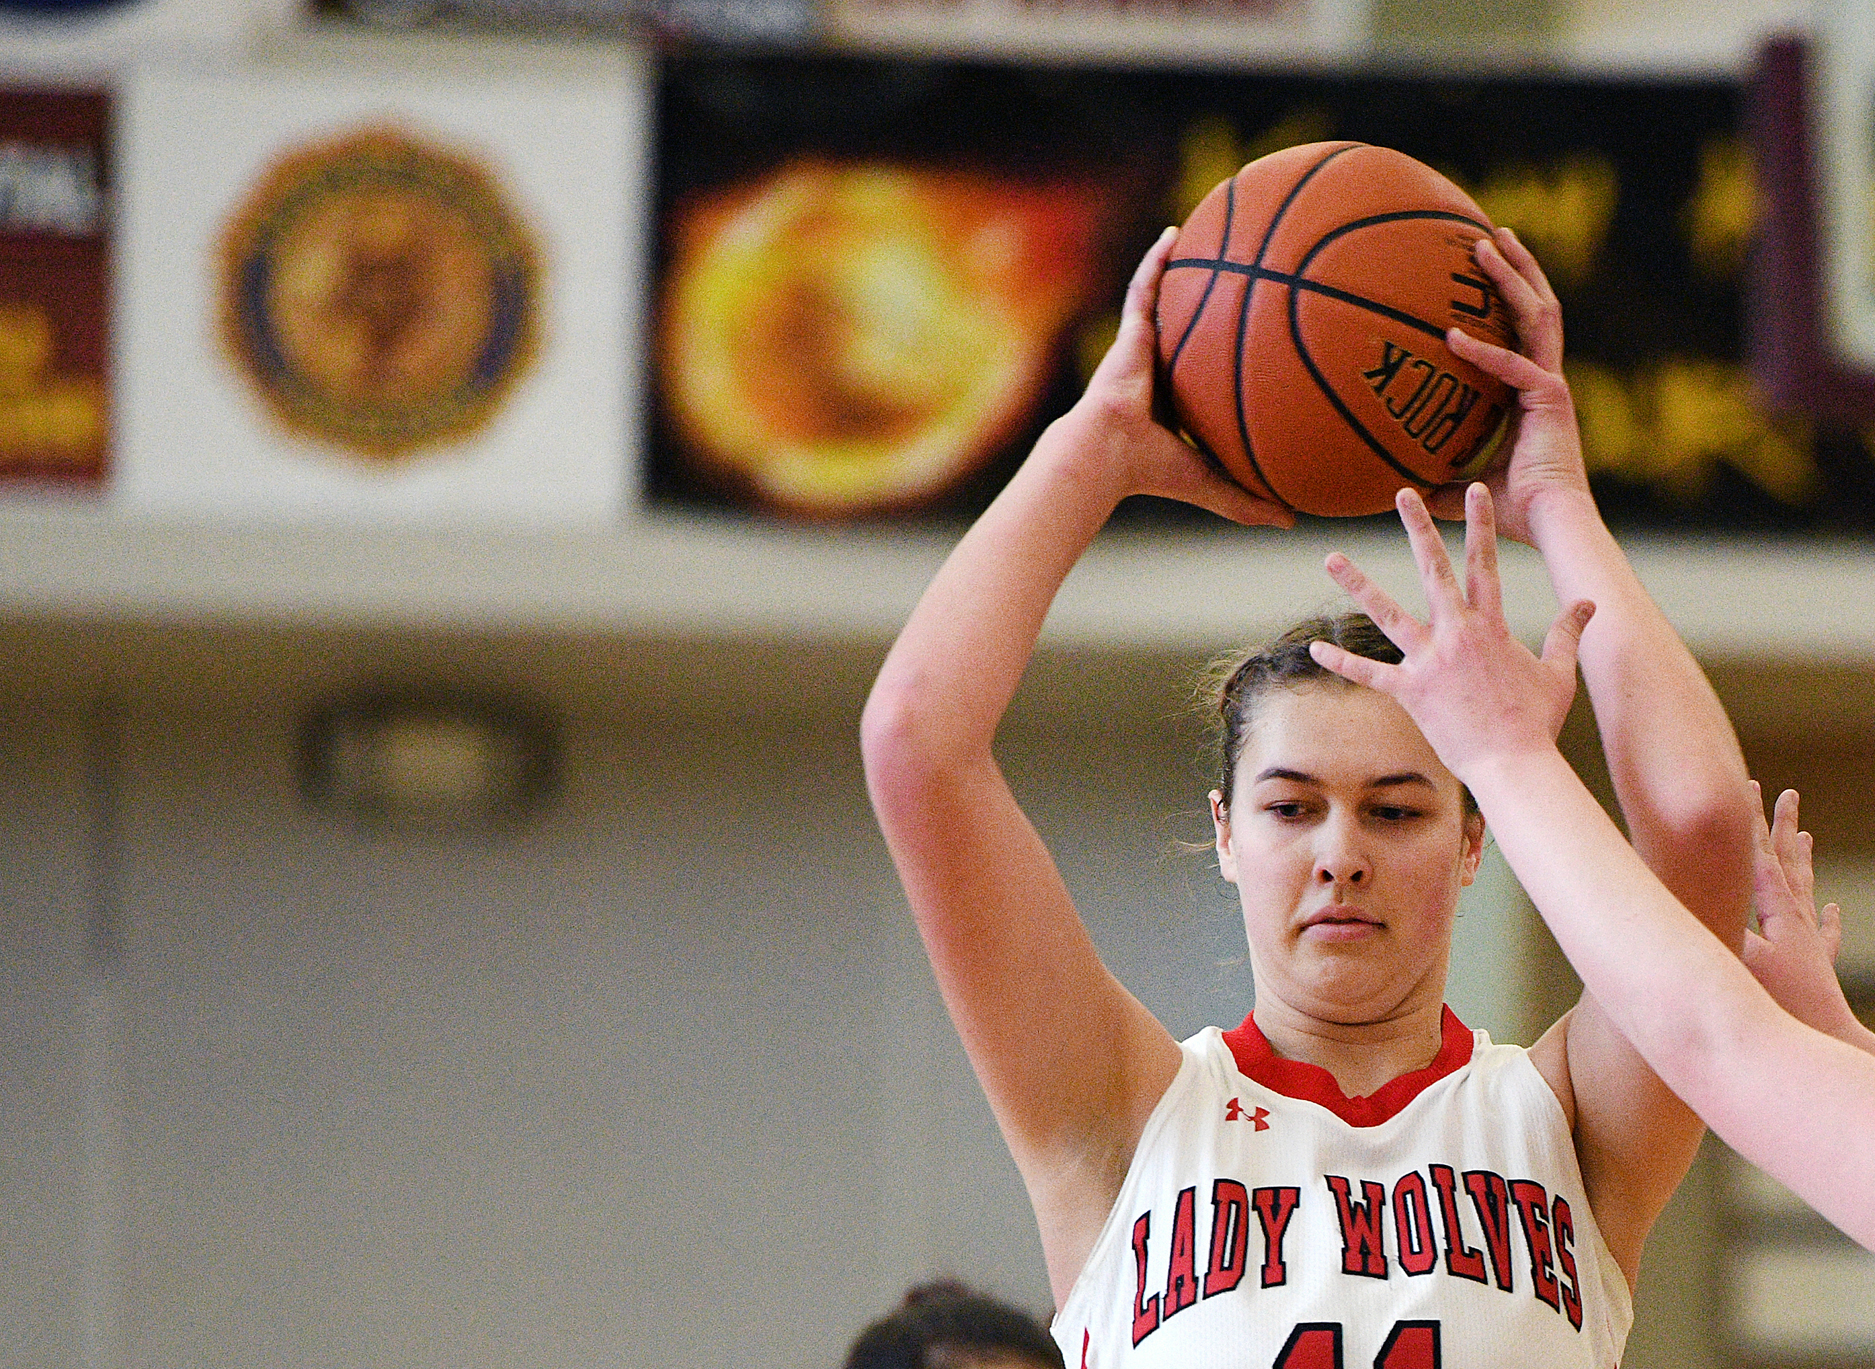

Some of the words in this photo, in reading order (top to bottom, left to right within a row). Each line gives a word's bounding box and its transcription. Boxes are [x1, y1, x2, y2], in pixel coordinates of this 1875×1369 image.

[1362, 339, 1484, 455] ROCK
[1131, 1177, 1301, 1349] LADY
[1323, 1163, 1583, 1333] WOLVES
